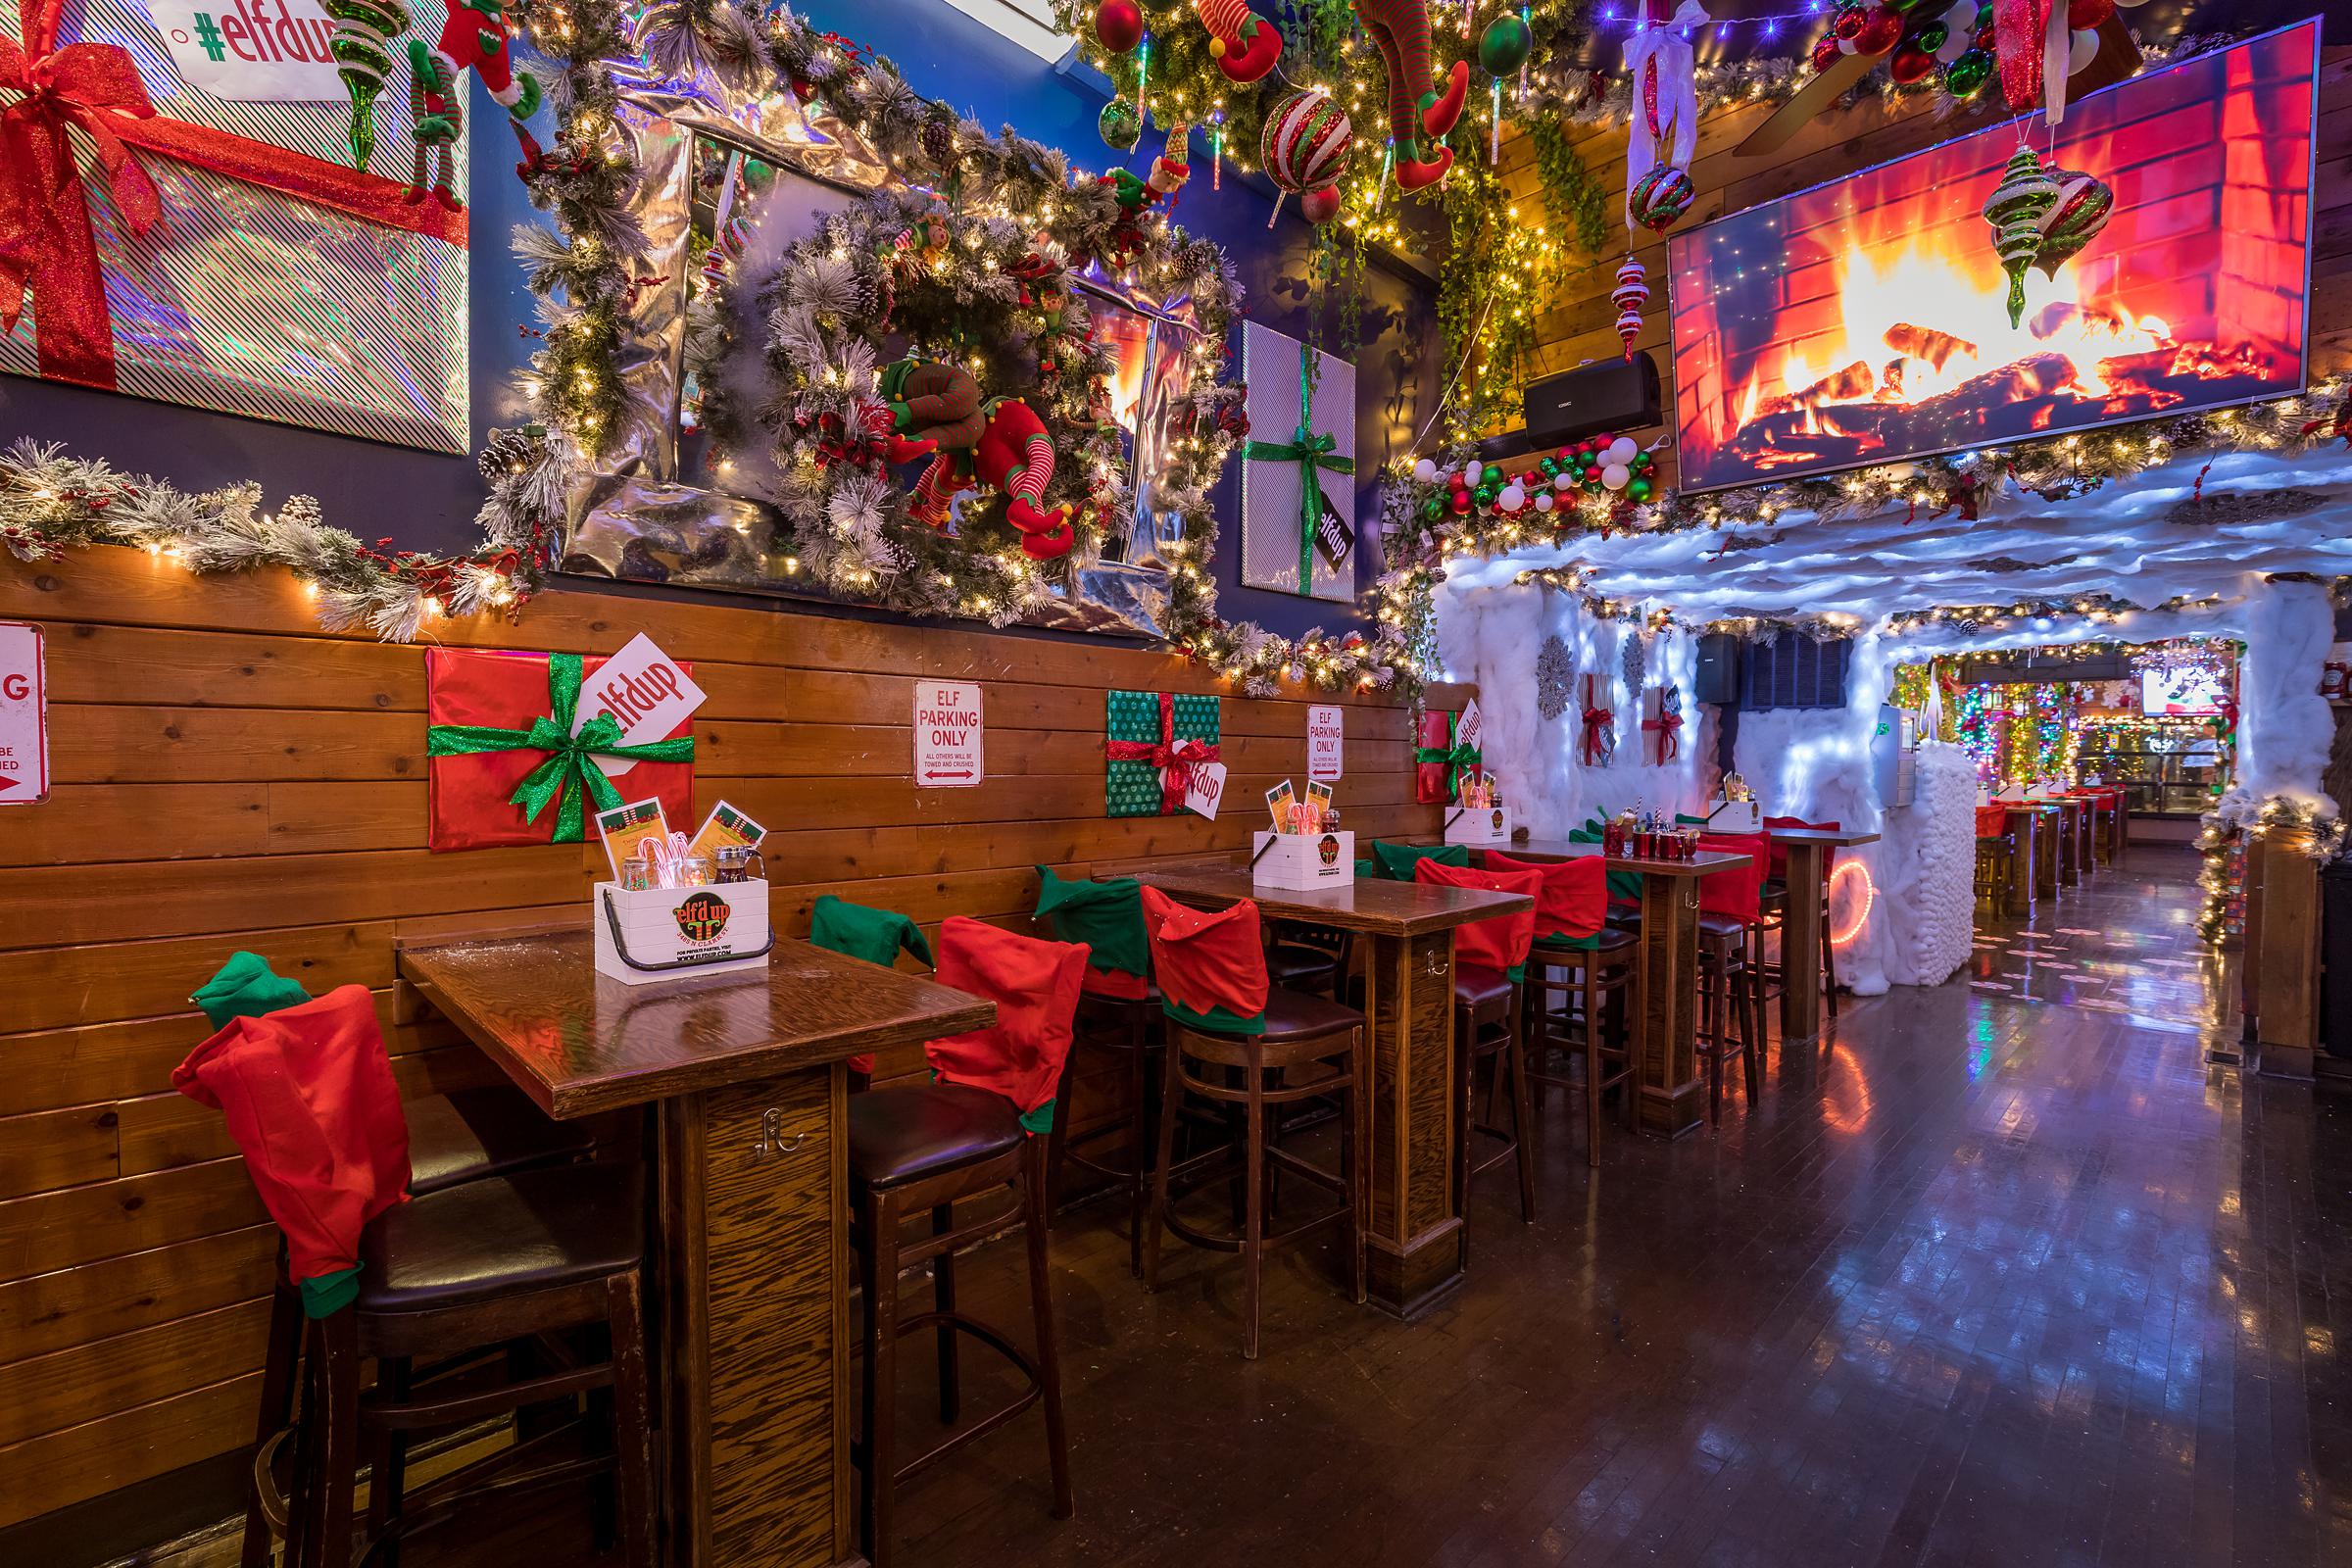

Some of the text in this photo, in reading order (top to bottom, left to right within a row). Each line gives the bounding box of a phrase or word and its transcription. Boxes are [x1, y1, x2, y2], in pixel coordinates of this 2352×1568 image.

[937, 690, 960, 707] ELF
[919, 710, 978, 727] PARKING
[1319, 711, 1332, 724] ELF
[931, 730, 967, 747] ONLY
[1310, 726, 1341, 739] PARKING
[1316, 740, 1335, 753] ONLY
[710, 904, 730, 926] up
